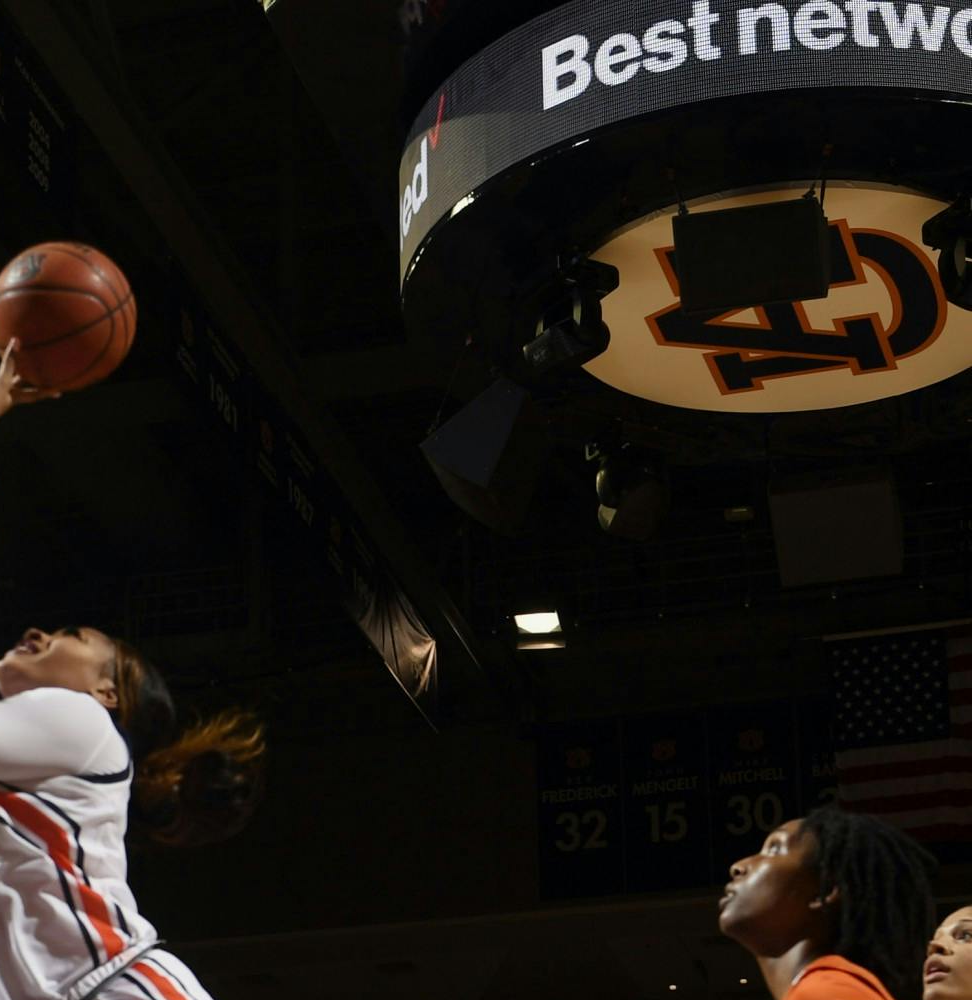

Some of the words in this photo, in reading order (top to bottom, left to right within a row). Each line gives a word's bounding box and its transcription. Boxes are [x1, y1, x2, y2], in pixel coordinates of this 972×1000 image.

[542, 0, 720, 111] Best
[210, 373, 238, 433] 1981
[540, 783, 619, 804] FREDERICK
[631, 775, 699, 797] MENGELT
[718, 767, 786, 786] MITCHELL
[555, 809, 609, 851] 32
[645, 800, 689, 843] 15
[727, 791, 785, 837] 30
